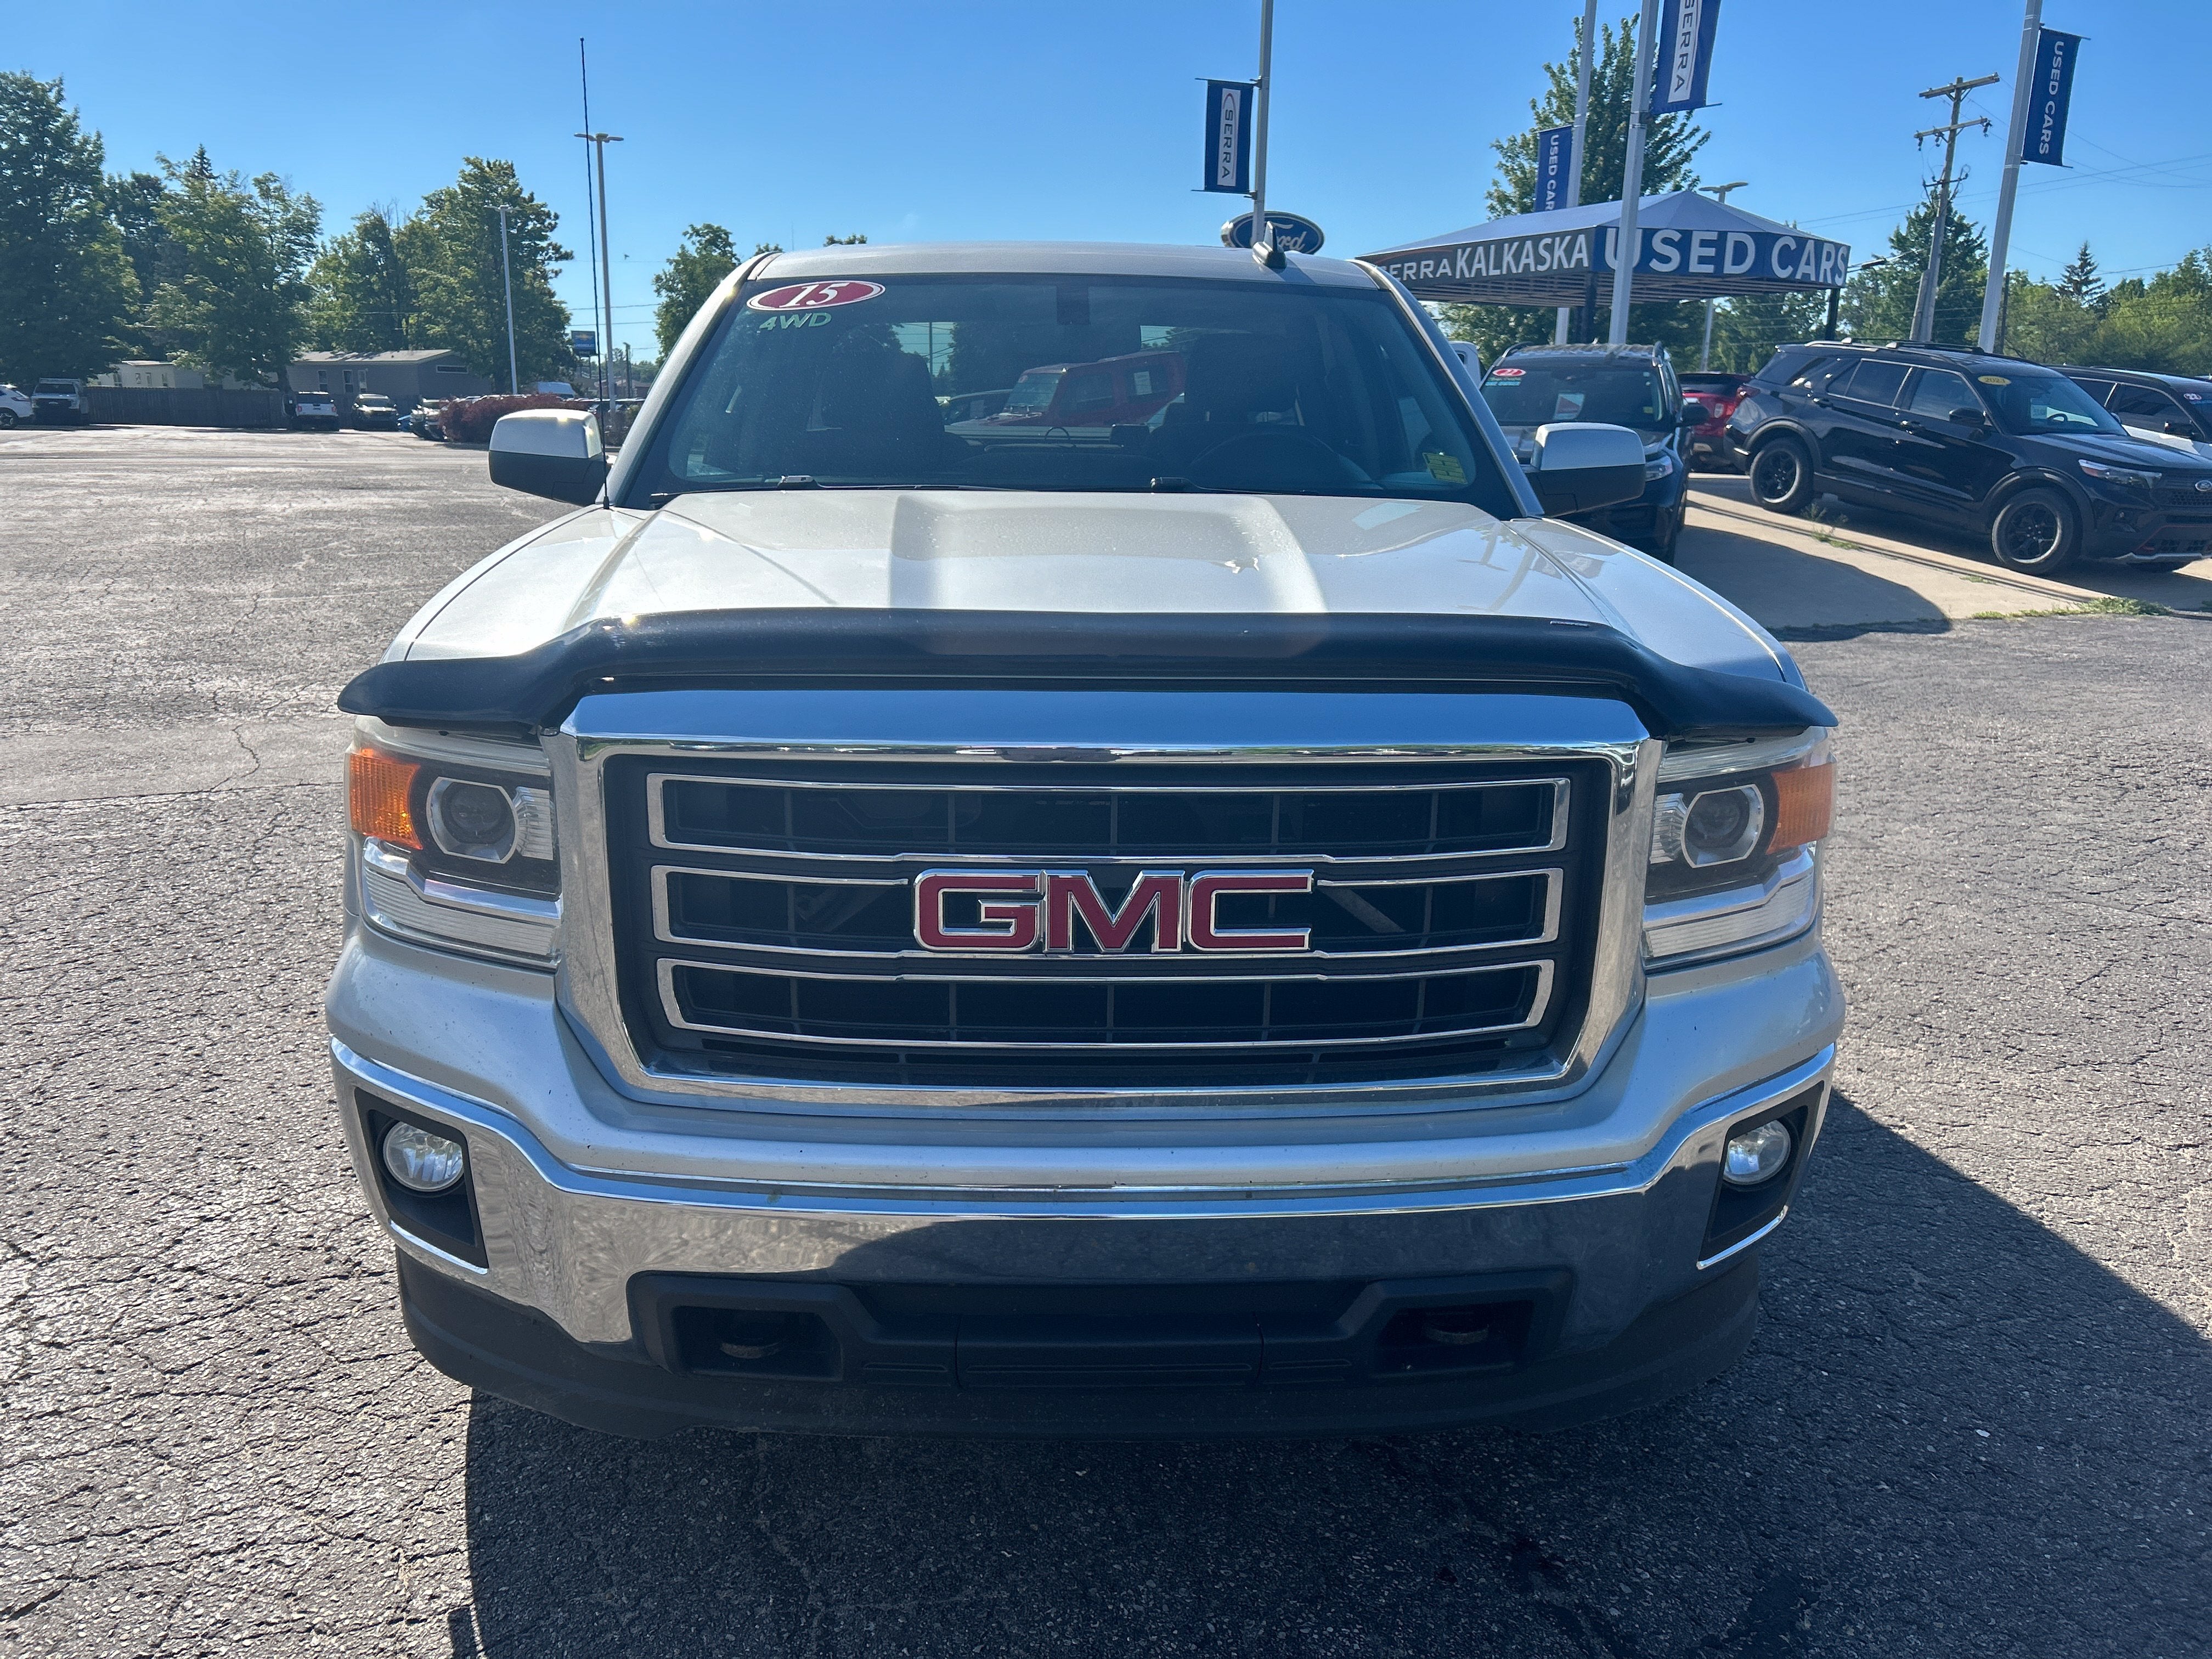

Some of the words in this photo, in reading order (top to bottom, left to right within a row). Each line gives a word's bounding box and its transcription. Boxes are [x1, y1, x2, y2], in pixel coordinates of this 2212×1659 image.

[2049, 41, 2064, 95] USED
[1221, 109, 1234, 179] SERRA
[2039, 100, 2056, 155] CARS
[1548, 134, 1559, 176] USED
[1544, 179, 1557, 211] CAR
[1455, 234, 1589, 279] KALKASKA
[1604, 228, 1756, 274] USED
[1771, 235, 1848, 286] CARS
[778, 281, 850, 308] 15
[759, 312, 832, 330] 4WD
[913, 868, 1314, 953] GMC
